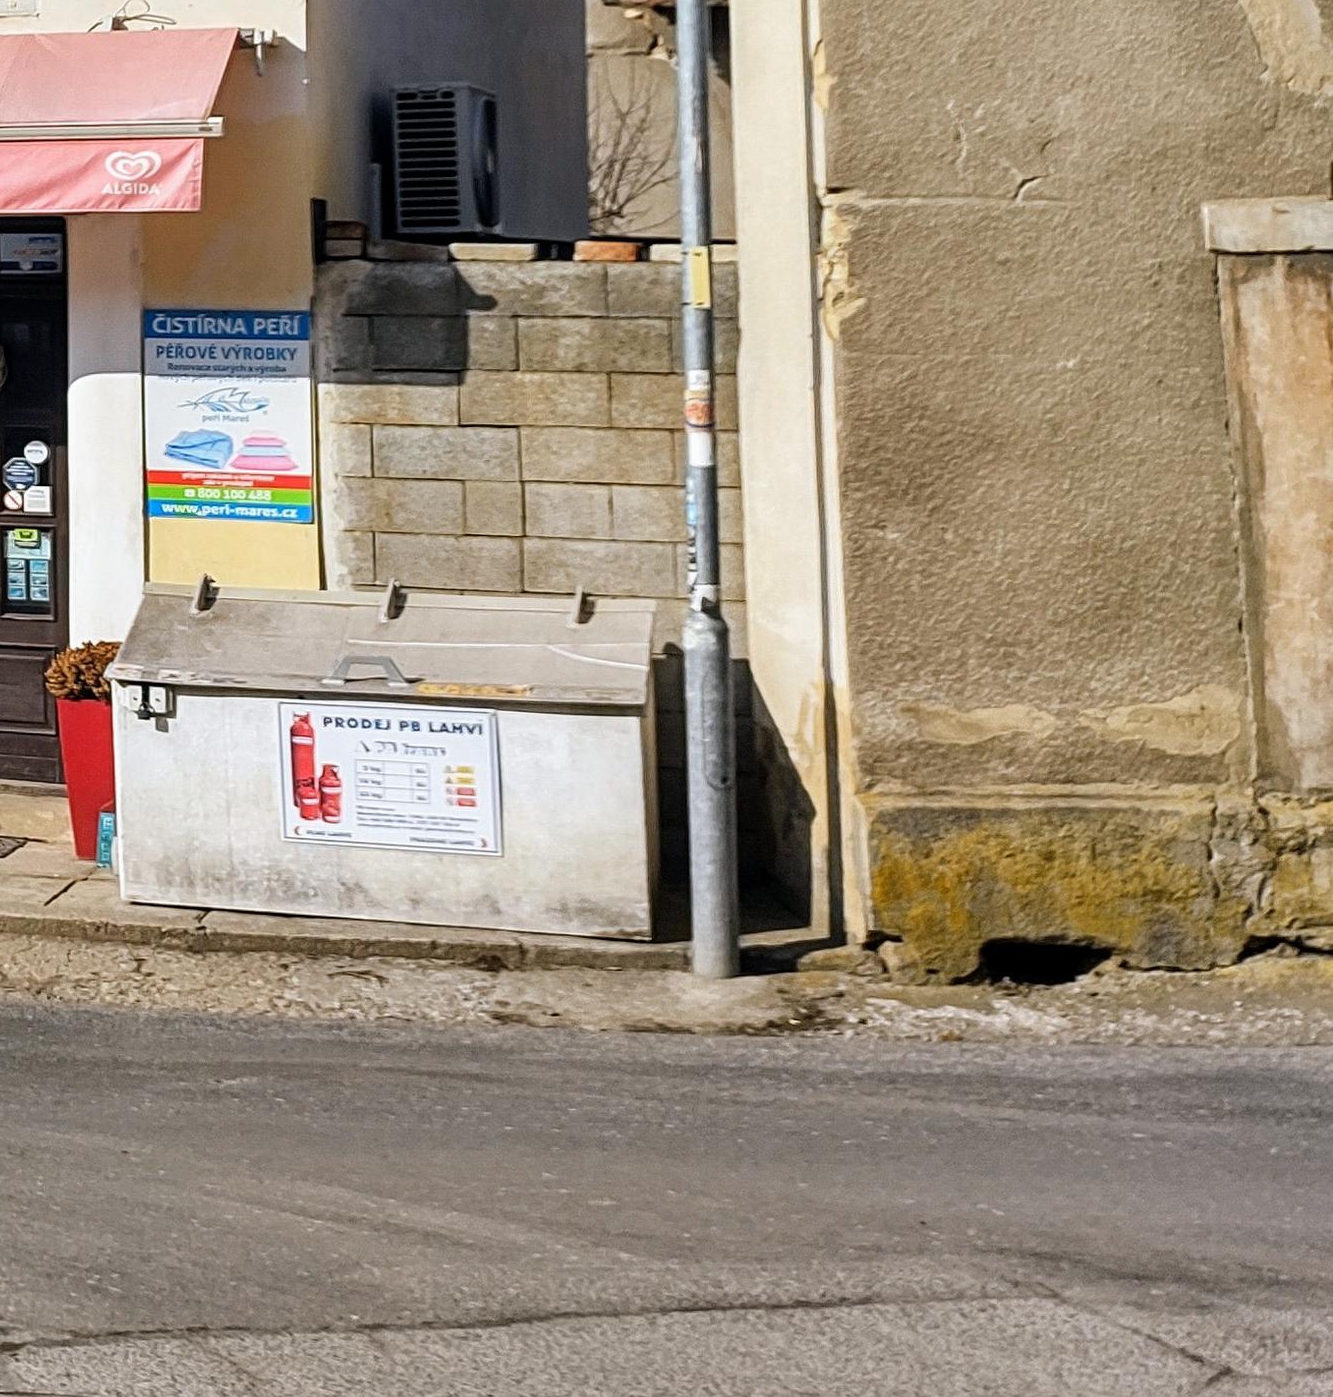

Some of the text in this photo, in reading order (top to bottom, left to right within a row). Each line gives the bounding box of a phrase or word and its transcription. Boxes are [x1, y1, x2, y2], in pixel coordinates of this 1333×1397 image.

[101, 182, 161, 195] ALGIDA
[152, 314, 301, 336] ČISTÍRNA PEŘÍ
[156, 343, 297, 362] PÉŘOVÉ VÝROBKY
[323, 716, 391, 731] PRODEJ
[399, 720, 421, 732] PB
